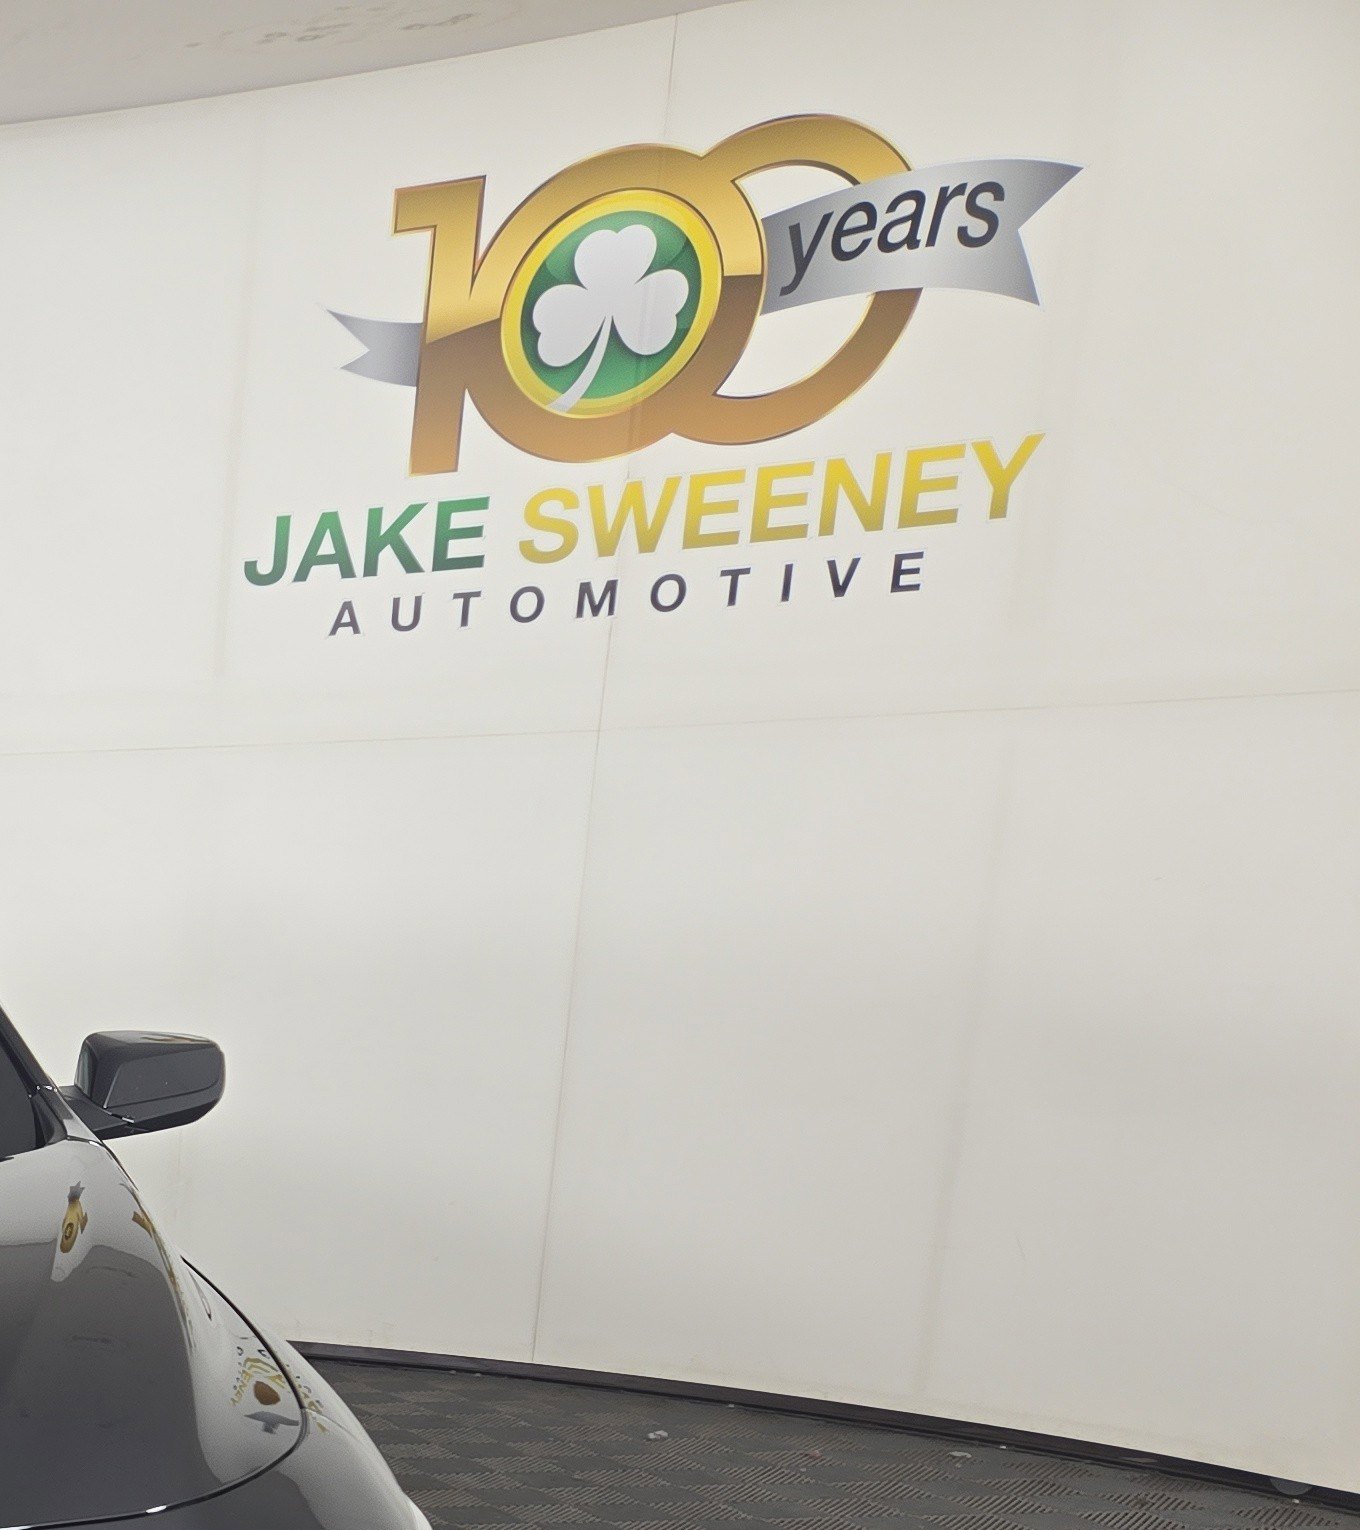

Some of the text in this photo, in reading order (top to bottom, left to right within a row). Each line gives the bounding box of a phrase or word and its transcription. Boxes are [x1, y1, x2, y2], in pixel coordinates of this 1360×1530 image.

[391, 114, 1006, 477] 100 years
[243, 432, 1046, 587] JAKE SWEENEY
[328, 551, 927, 637] AUTOMOTIVE
